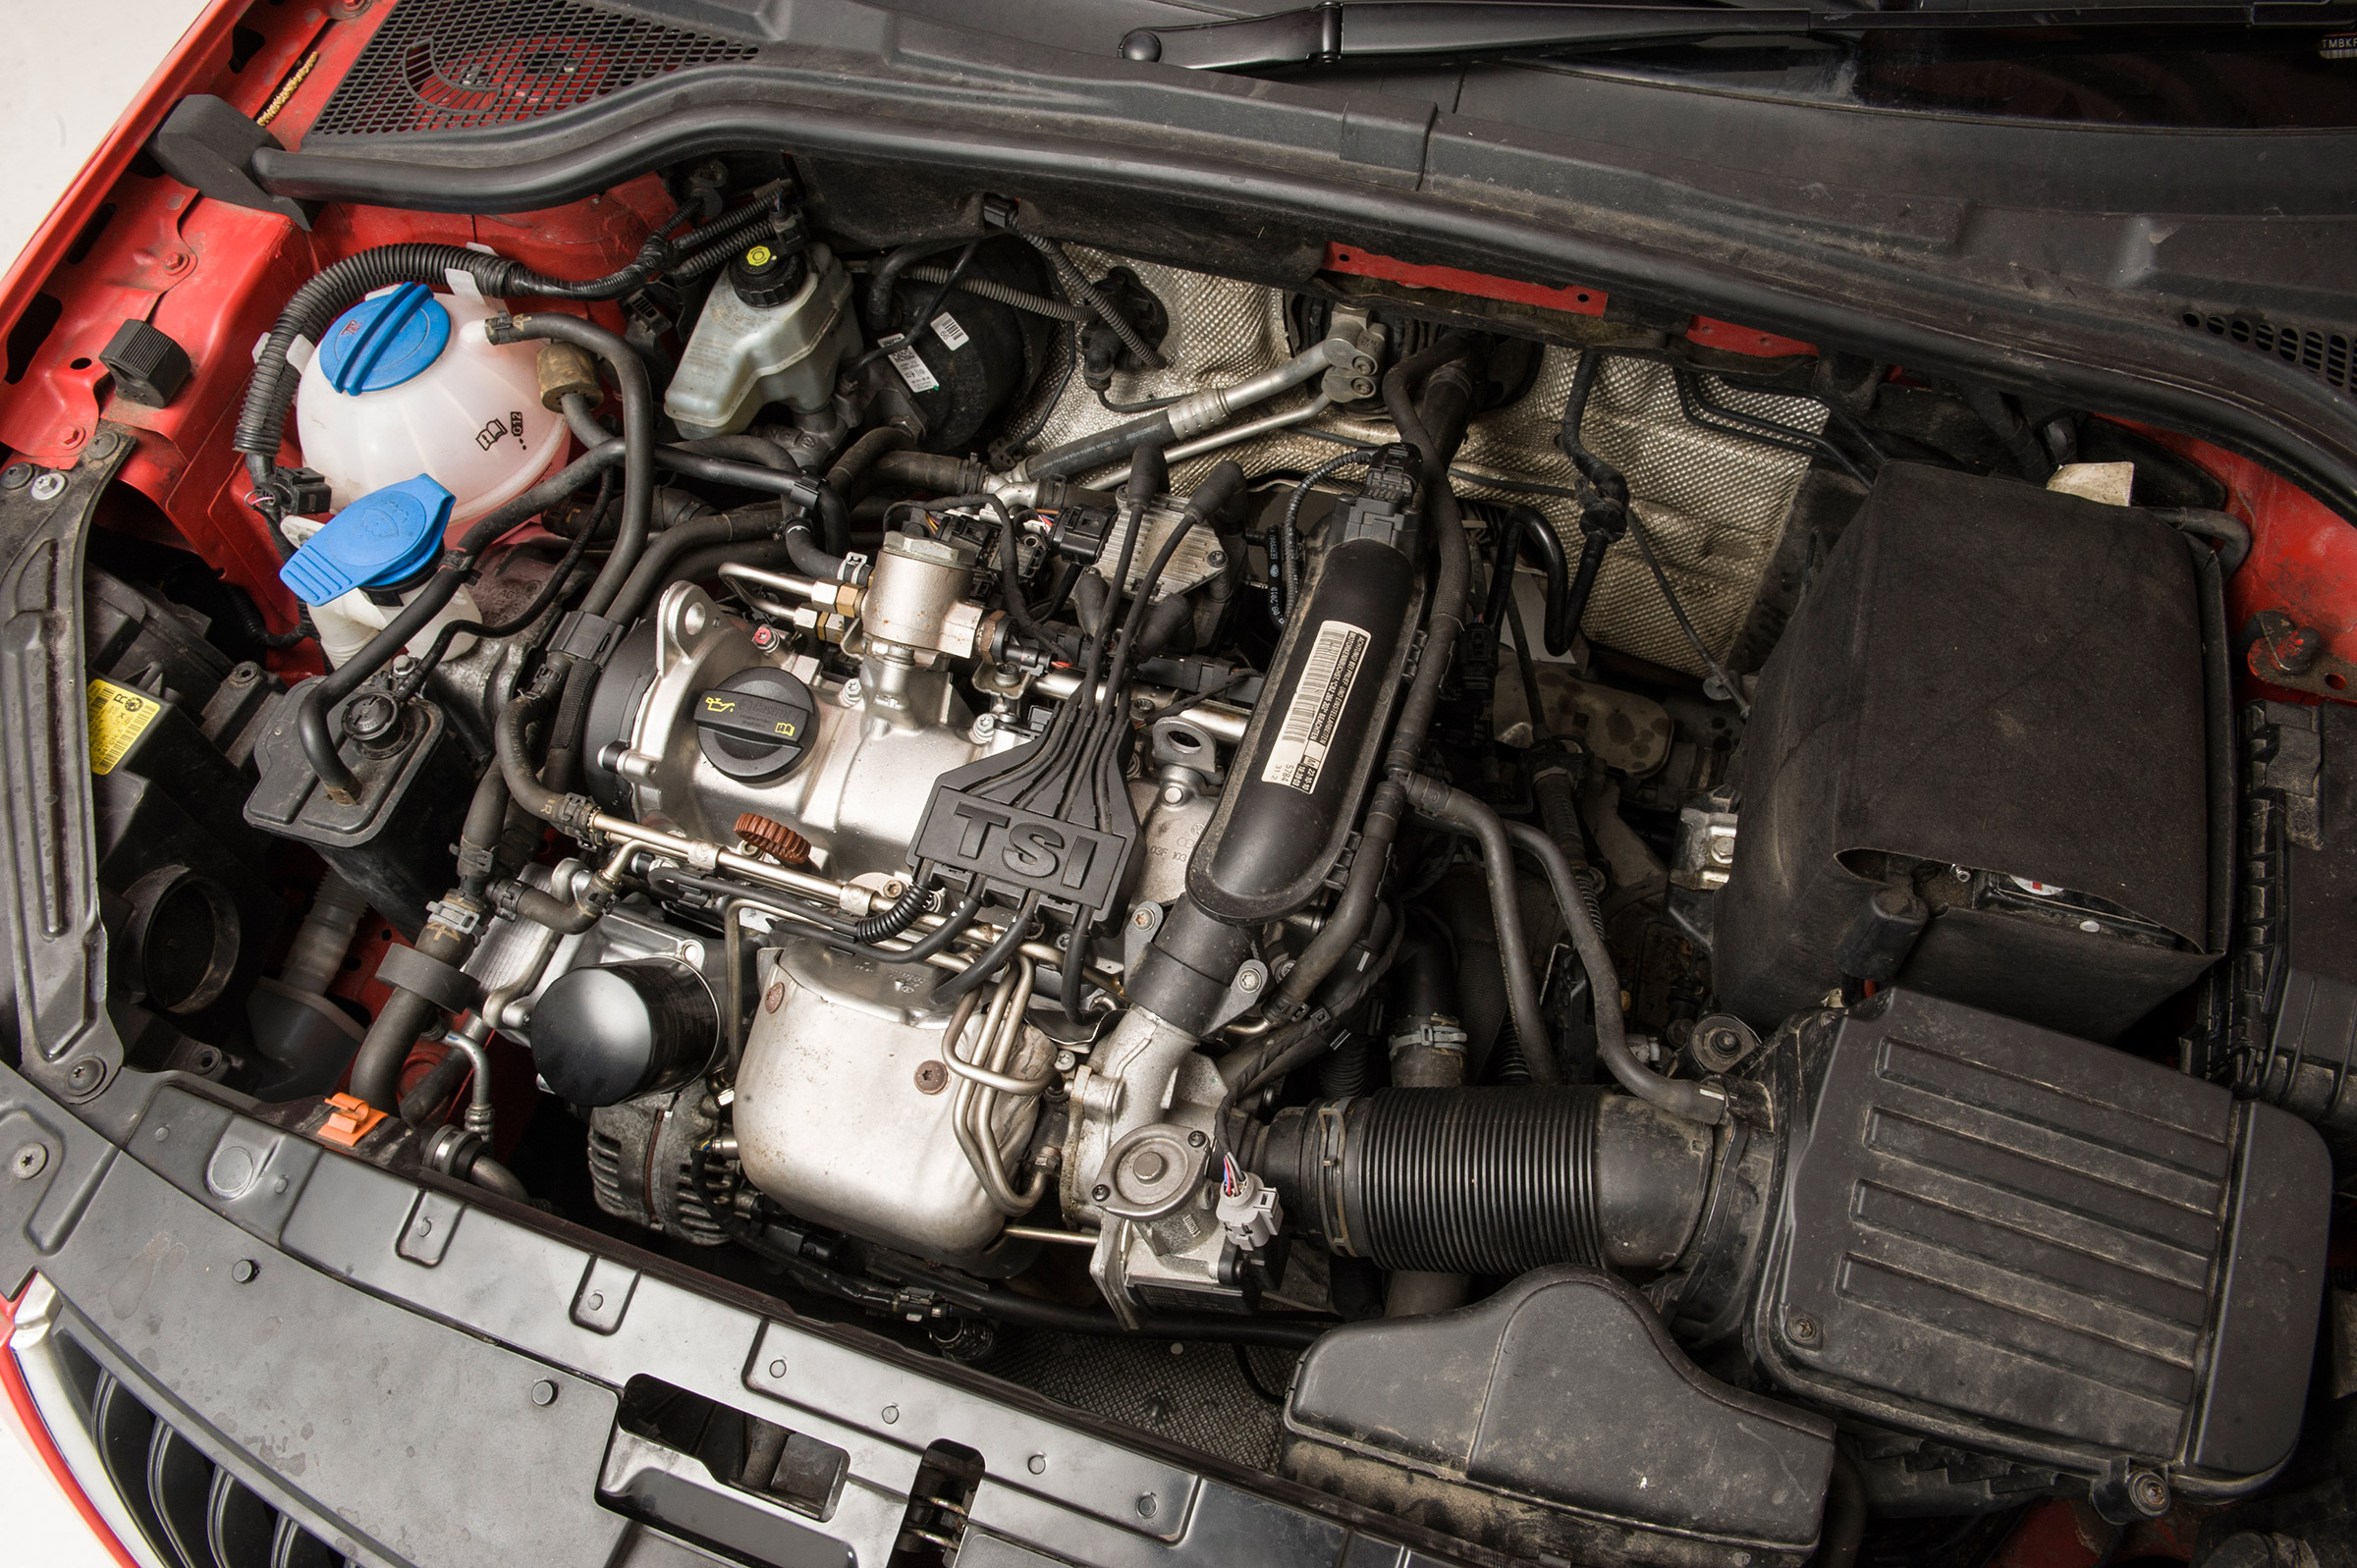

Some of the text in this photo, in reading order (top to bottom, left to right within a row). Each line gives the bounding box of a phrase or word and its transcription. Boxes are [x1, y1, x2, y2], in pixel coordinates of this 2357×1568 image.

[512, 412, 522, 435] G12
[113, 693, 127, 704] R
[1281, 764, 1294, 782] 5784
[540, 803, 552, 814] R
[955, 802, 1098, 890] TSI
[1150, 845, 1187, 862] 03F 103
